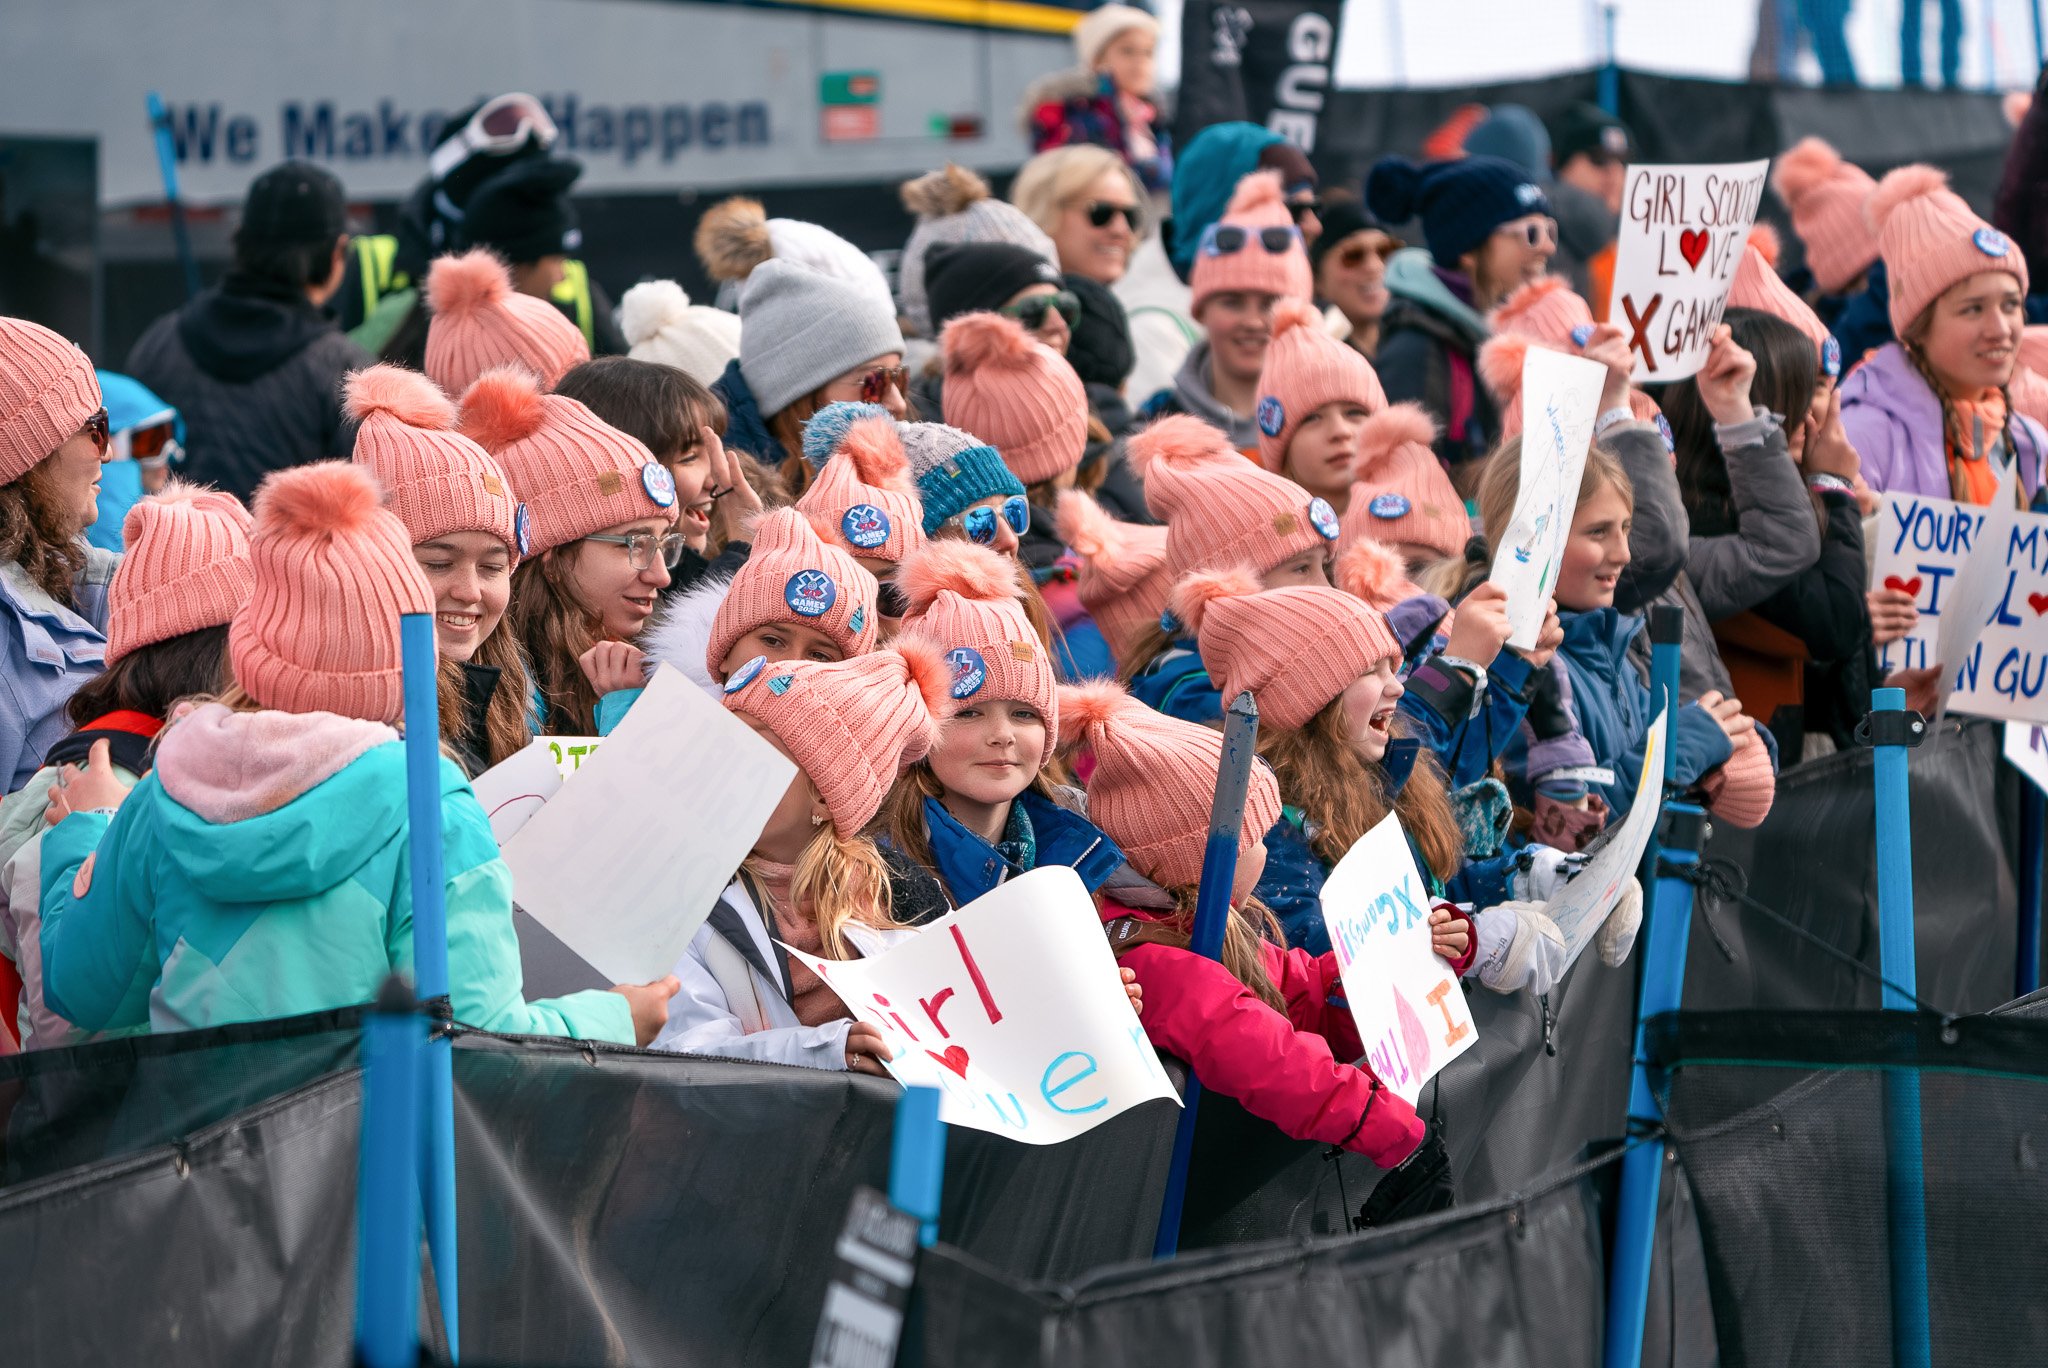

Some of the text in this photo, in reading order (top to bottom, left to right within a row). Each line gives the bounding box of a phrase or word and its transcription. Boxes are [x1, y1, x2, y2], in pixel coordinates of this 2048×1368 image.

[162, 92, 770, 167] We Make Happen
[1630, 170, 1691, 235] GIRL
[1621, 292, 1663, 373] X
[2006, 524, 2048, 577] M
[792, 598, 826, 609] GAMES
[954, 668, 982, 695] GAMES
